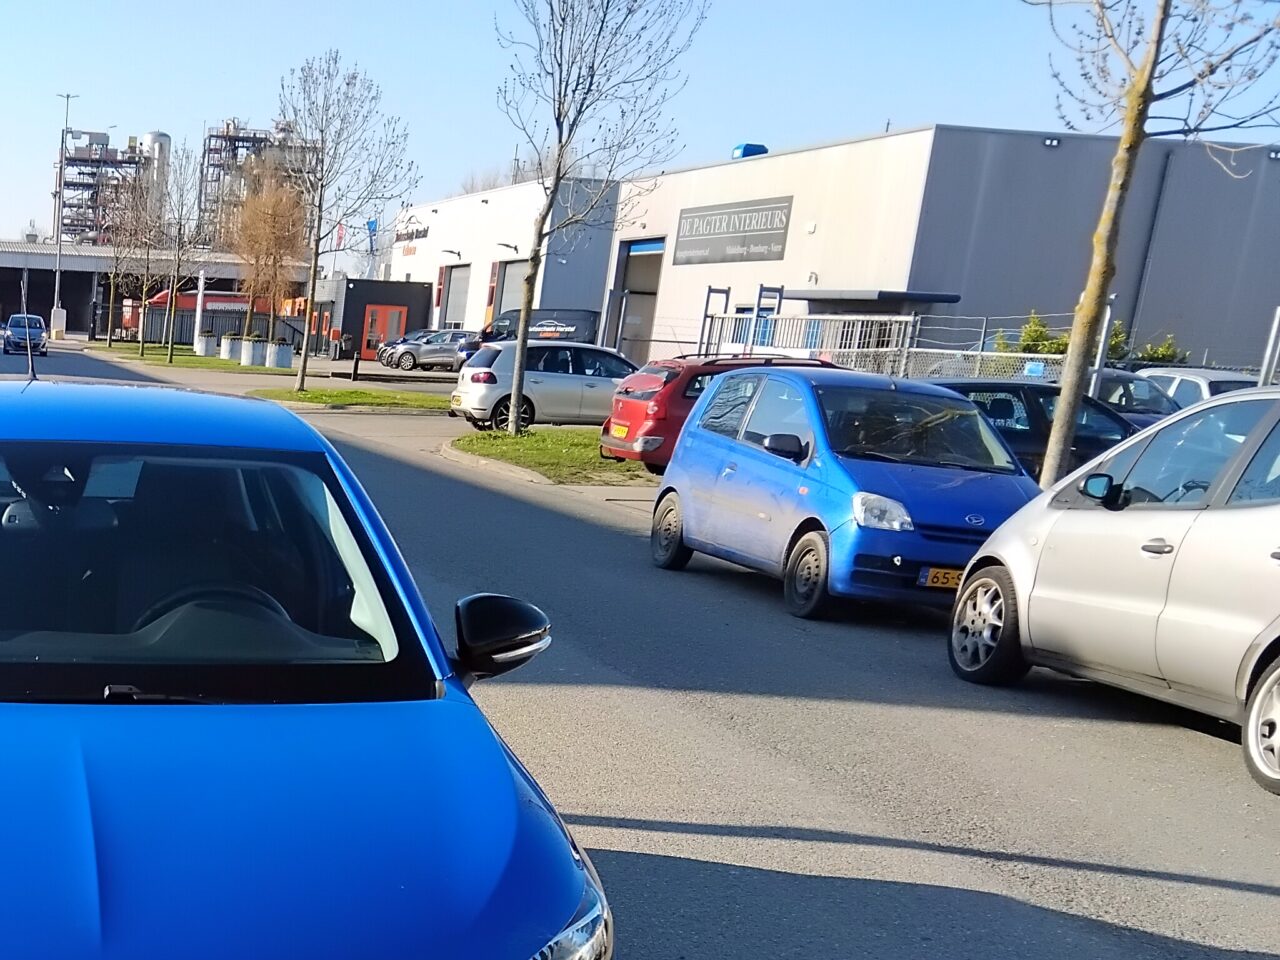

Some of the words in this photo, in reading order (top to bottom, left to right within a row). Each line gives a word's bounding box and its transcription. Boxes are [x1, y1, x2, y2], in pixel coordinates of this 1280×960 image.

[680, 218, 692, 236] DE
[692, 214, 728, 235] PAGTER
[730, 209, 787, 231] INTERIEURS
